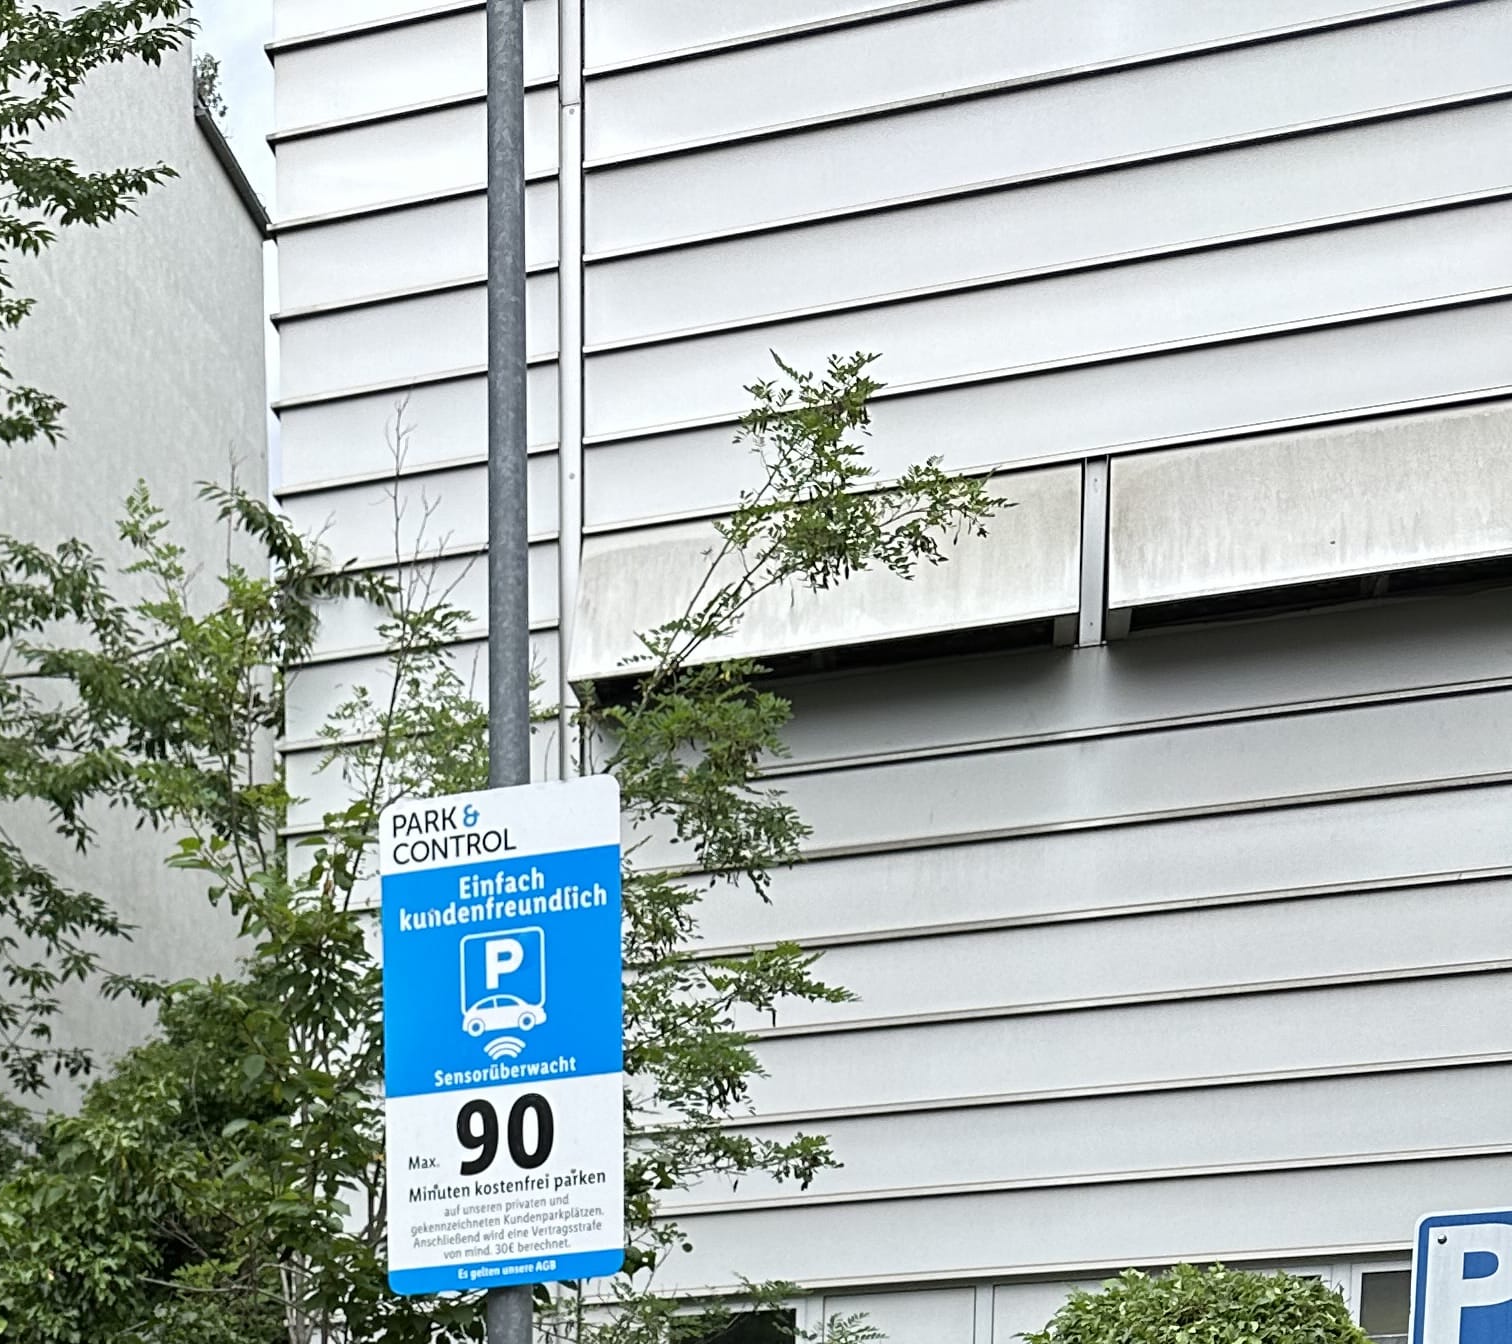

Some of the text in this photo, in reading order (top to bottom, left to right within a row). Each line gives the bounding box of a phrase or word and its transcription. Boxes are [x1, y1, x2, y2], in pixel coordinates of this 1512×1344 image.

[392, 803, 480, 838] PARK &
[392, 828, 517, 865] CONTROL
[459, 866, 545, 900] Einfach
[399, 882, 607, 932] kundenfreundlich
[485, 938, 524, 990] P
[434, 1056, 577, 1088] Sensorüberwacht
[408, 1093, 555, 1176] Max. 90
[408, 1170, 607, 1203] Minuten kostenfrei parken
[444, 1193, 569, 1217] auf unseren privaten und
[411, 1207, 605, 1237] gekennzeichneten Kundenparkplätzen.
[413, 1219, 603, 1249] Anschließend wird eine Vertragsstrafe
[443, 1249, 462, 1259] von
[495, 1241, 515, 1255] 30€
[517, 1238, 571, 1252] berechnet.
[457, 1259, 557, 1281] Es gelten unsere AGB
